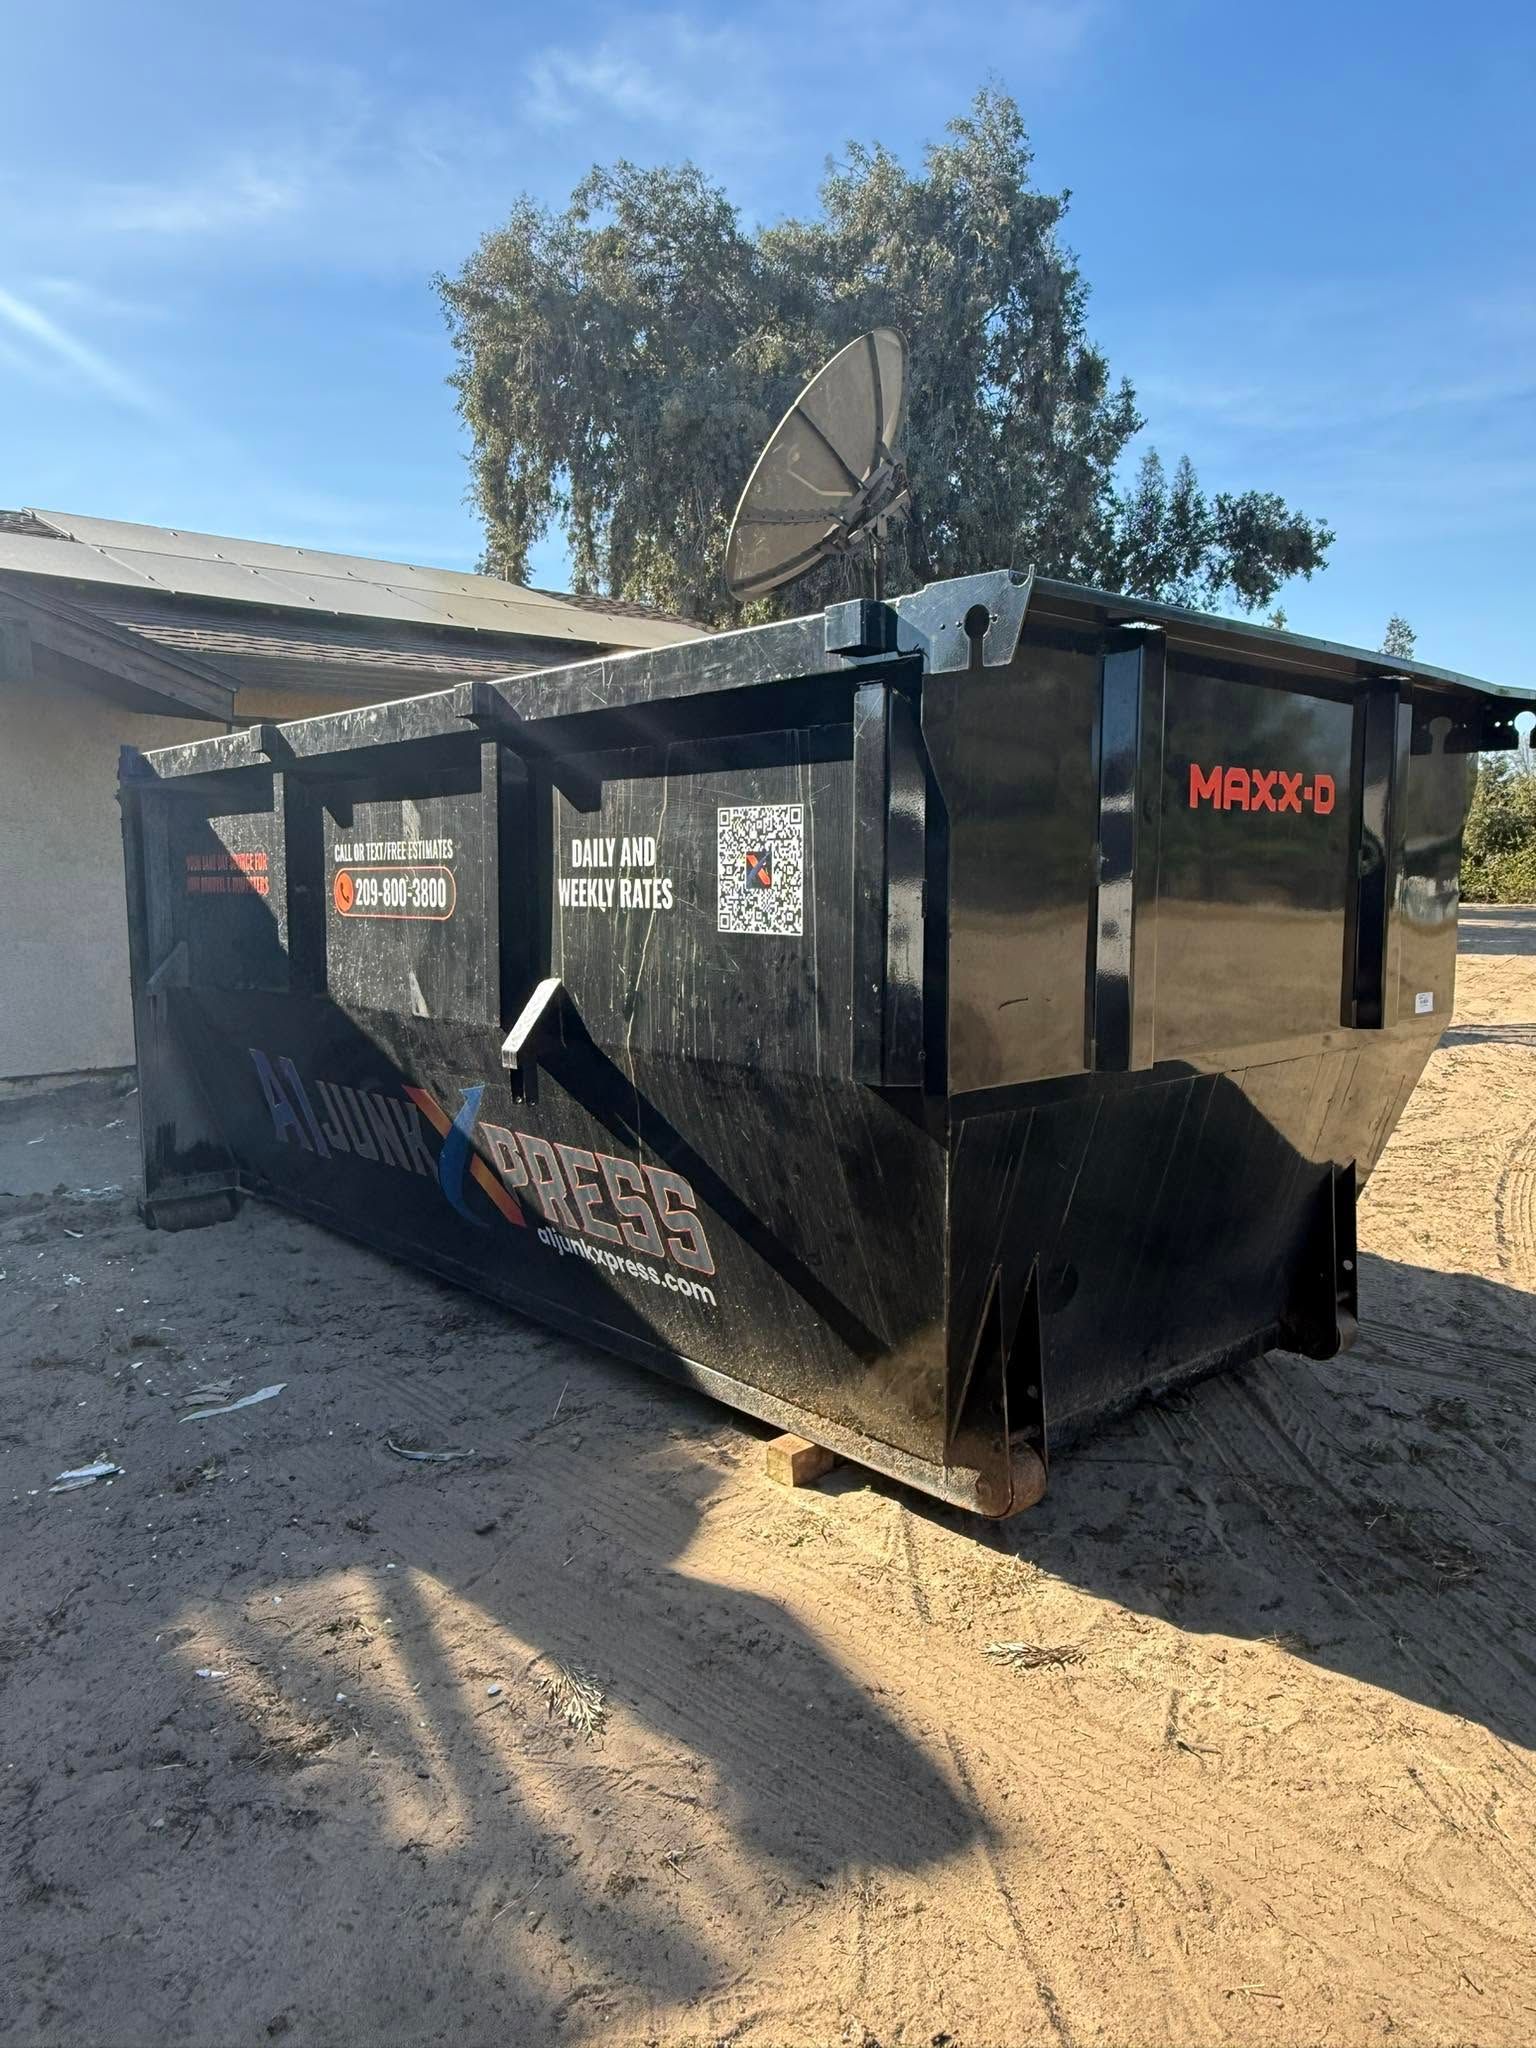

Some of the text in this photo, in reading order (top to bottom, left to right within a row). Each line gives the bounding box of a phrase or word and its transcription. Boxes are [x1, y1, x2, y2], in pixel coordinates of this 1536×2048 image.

[1189, 763, 1335, 815] MAXX-D
[334, 838, 454, 863] CALL OR TEXT/FREE ESTIMATES
[571, 836, 657, 868] DAILY AND
[355, 876, 447, 909] 209-800-3800
[558, 878, 674, 911] WEEKLY RATES
